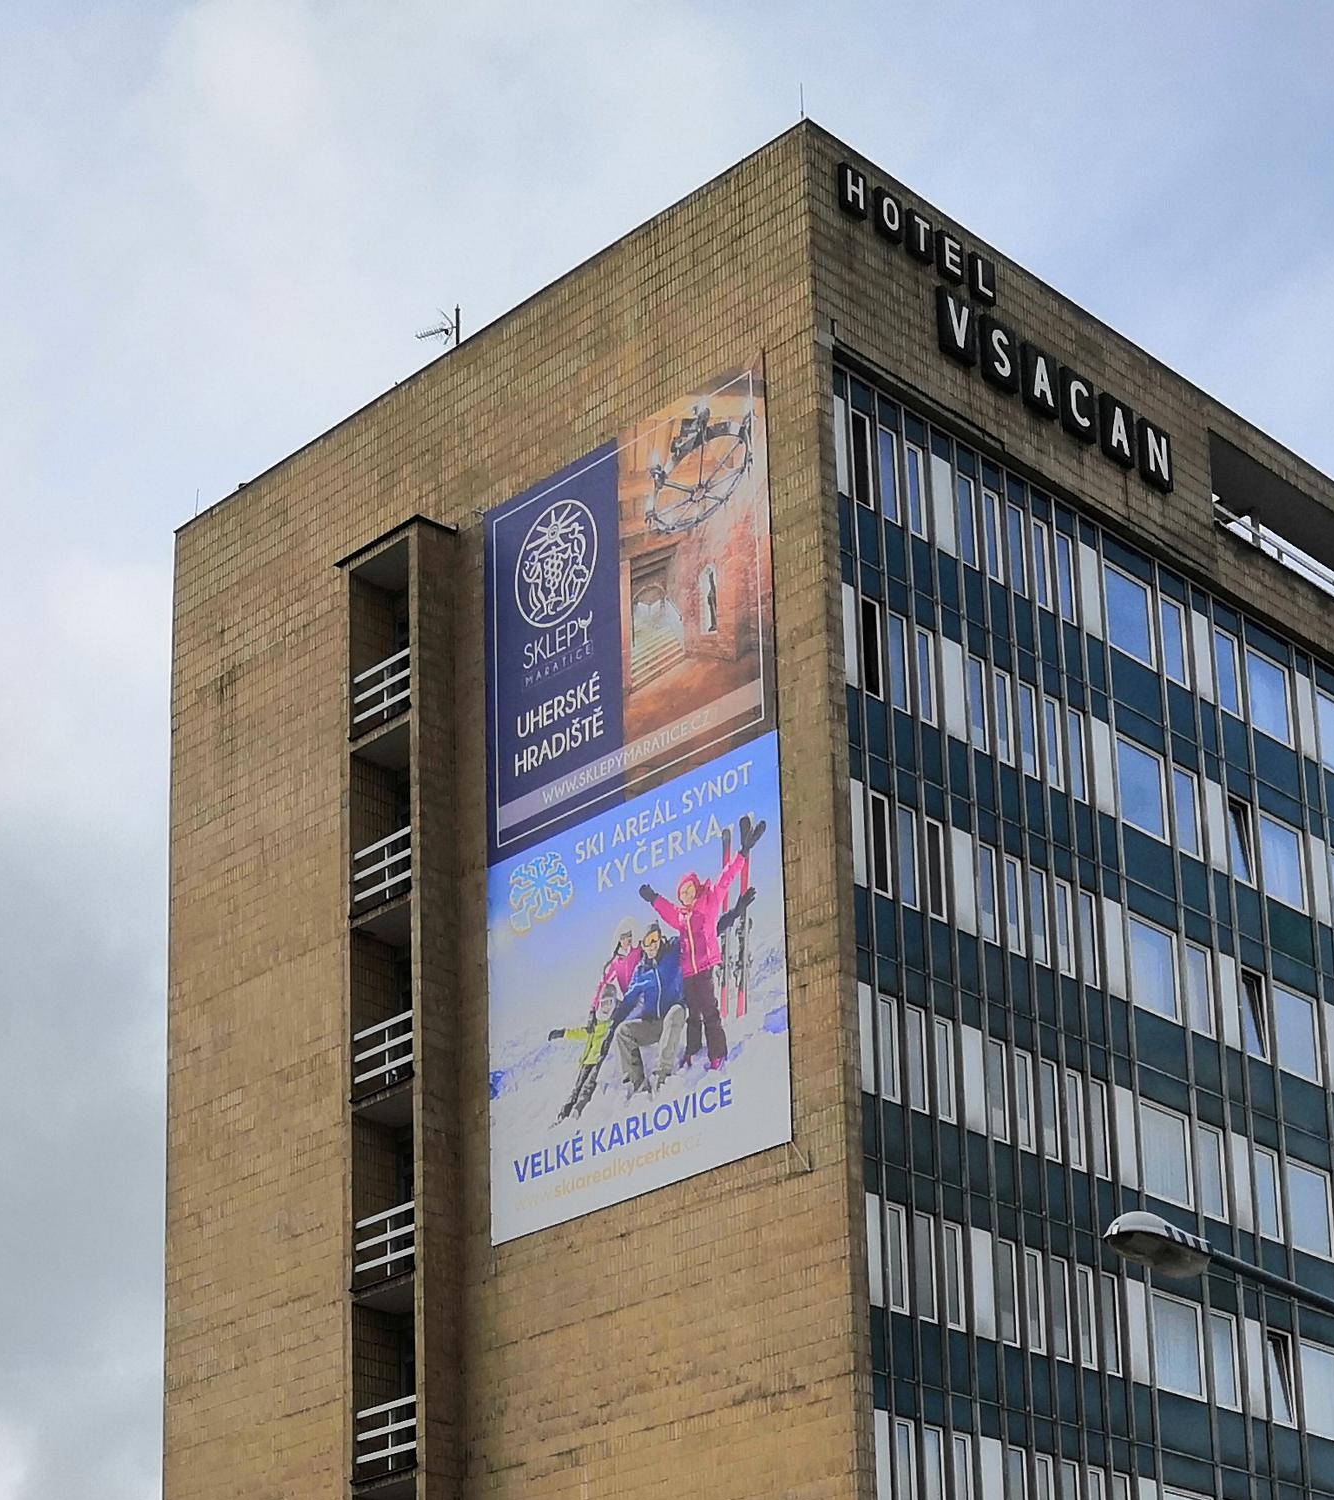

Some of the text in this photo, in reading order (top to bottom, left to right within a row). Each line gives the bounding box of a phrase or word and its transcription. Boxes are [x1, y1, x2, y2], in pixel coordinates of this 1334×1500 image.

[846, 167, 994, 297] HOTEL
[947, 296, 1170, 482] VSACAN
[523, 611, 593, 669] SKLEPY
[514, 707, 605, 777] HRADIŠTĚ
[517, 672, 601, 738] UHERSKÉ
[575, 760, 754, 865] SKI AREÁL SYNOT
[597, 812, 723, 893] KYČERKA
[513, 1079, 733, 1184] VELKÉ KARLOVICE
